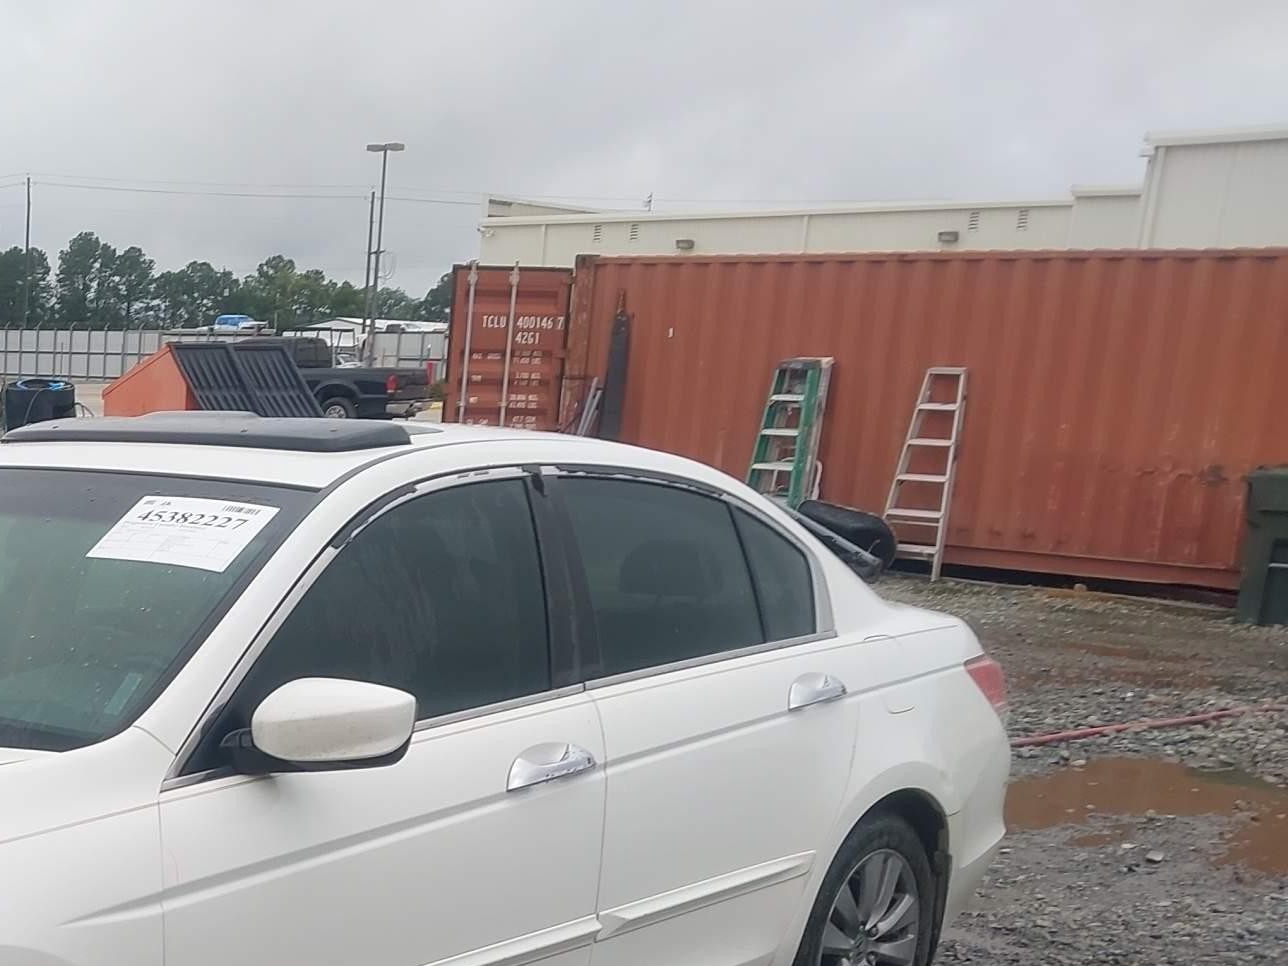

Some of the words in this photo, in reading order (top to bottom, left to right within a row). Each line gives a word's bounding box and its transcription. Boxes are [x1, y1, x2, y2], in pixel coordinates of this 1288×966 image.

[482, 315, 507, 328] TCLU
[517, 316, 554, 329] 400146
[137, 509, 249, 530] 45382227
